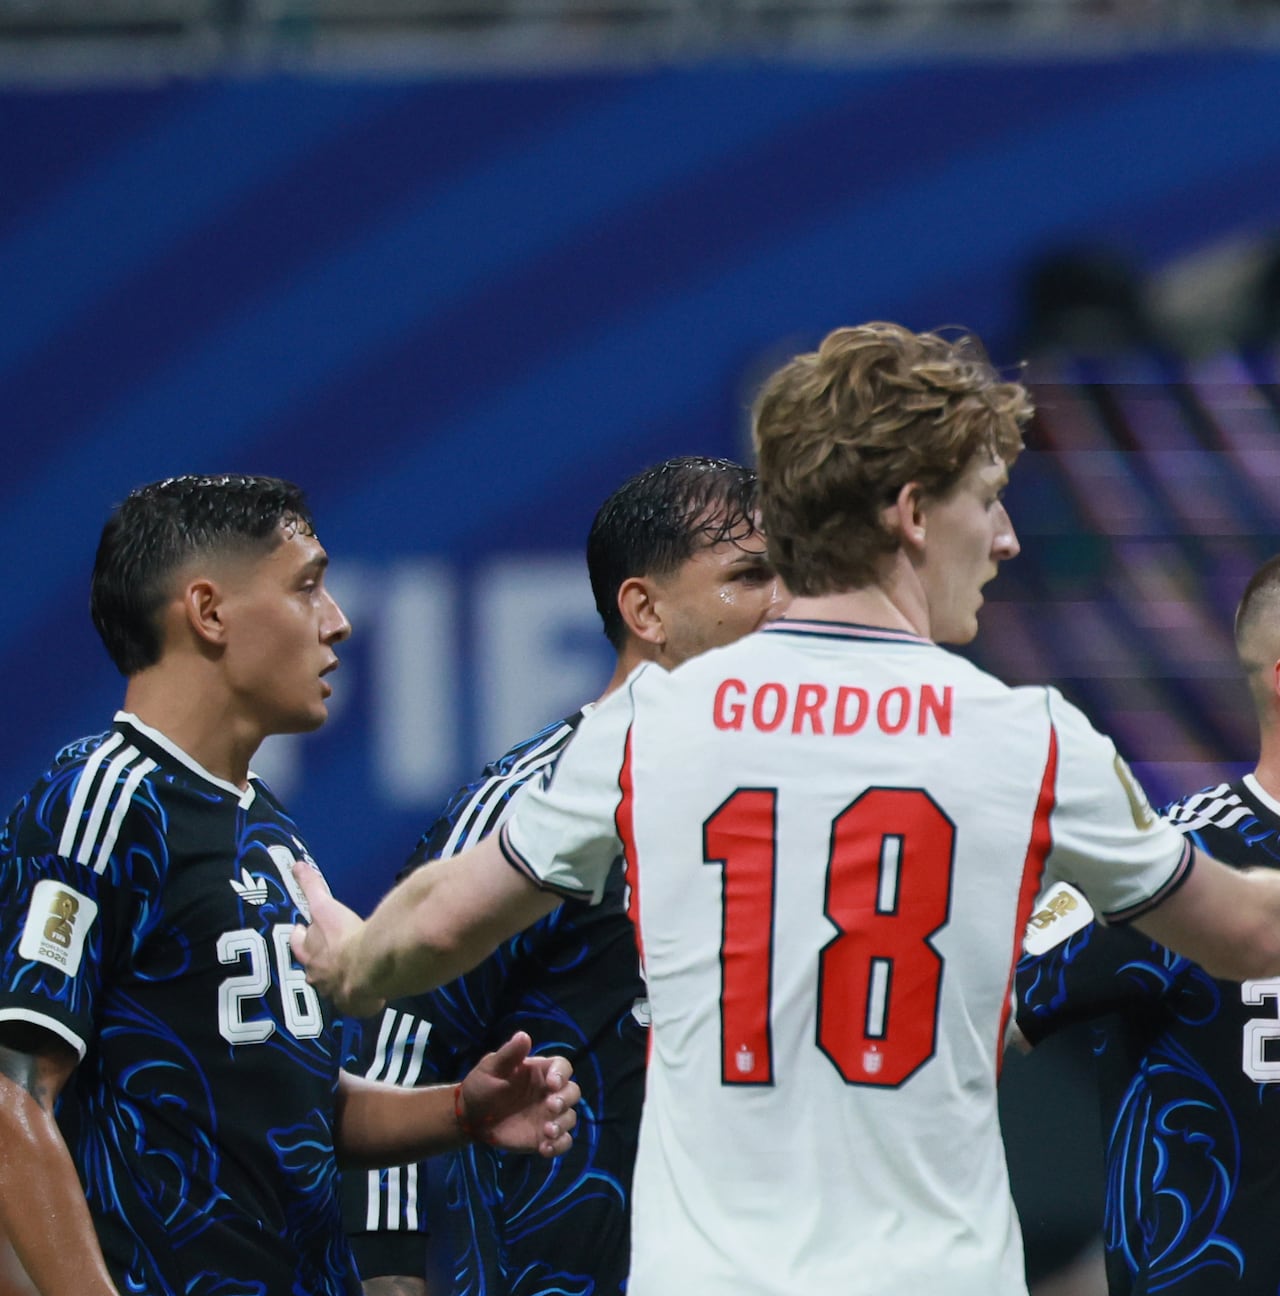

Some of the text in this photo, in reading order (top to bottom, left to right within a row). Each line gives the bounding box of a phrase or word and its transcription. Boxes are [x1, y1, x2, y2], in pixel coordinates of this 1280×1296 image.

[713, 678, 954, 737] GORDON
[216, 923, 323, 1046] 26
[702, 787, 956, 1089] 18
